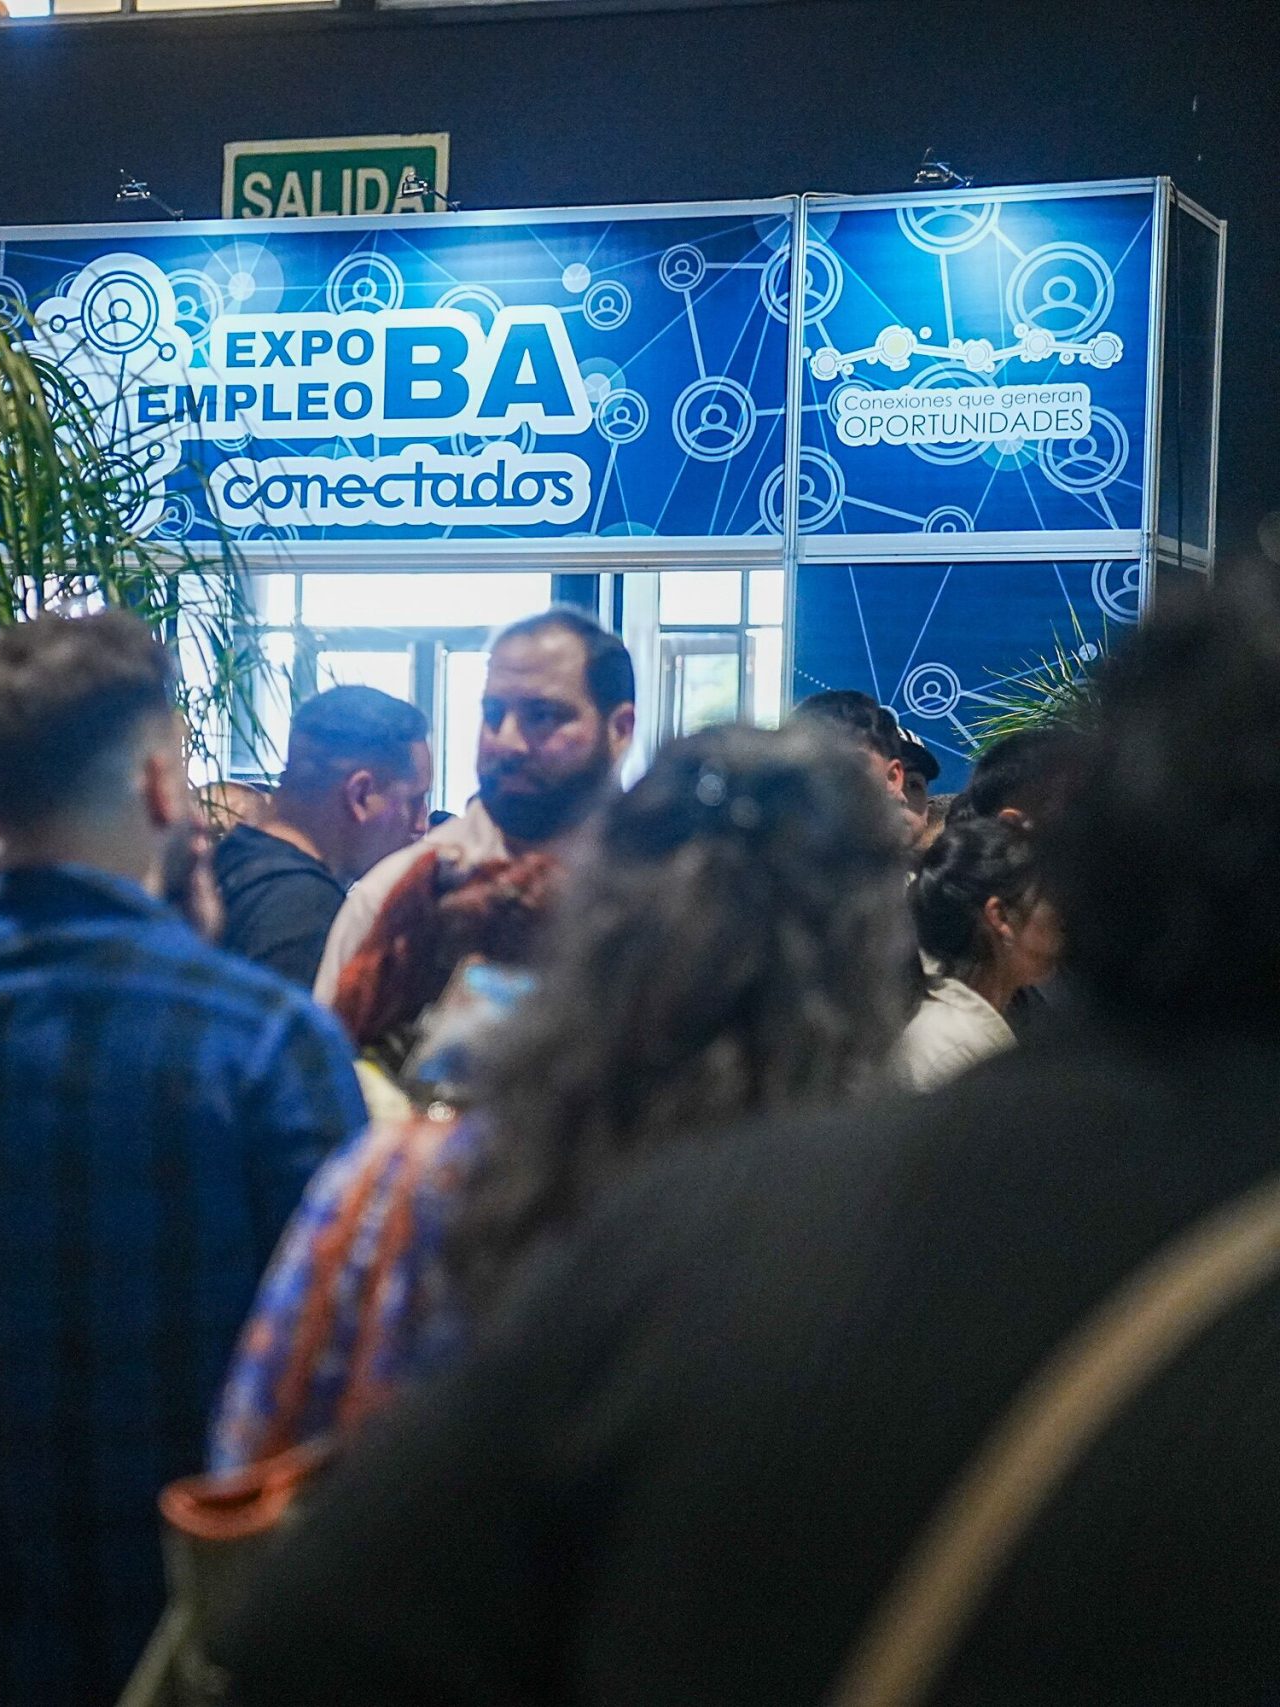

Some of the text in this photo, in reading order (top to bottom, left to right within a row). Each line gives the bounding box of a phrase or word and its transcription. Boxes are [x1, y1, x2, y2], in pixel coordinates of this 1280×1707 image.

[241, 165, 425, 219] SALIDA
[225, 328, 375, 368] EXPO
[383, 322, 576, 420] BA
[137, 381, 373, 423] EMPLEO
[843, 389, 1083, 411] Conexiones que generan
[843, 408, 1084, 439] OPORTUNIDADES
[222, 459, 574, 510] conectados
